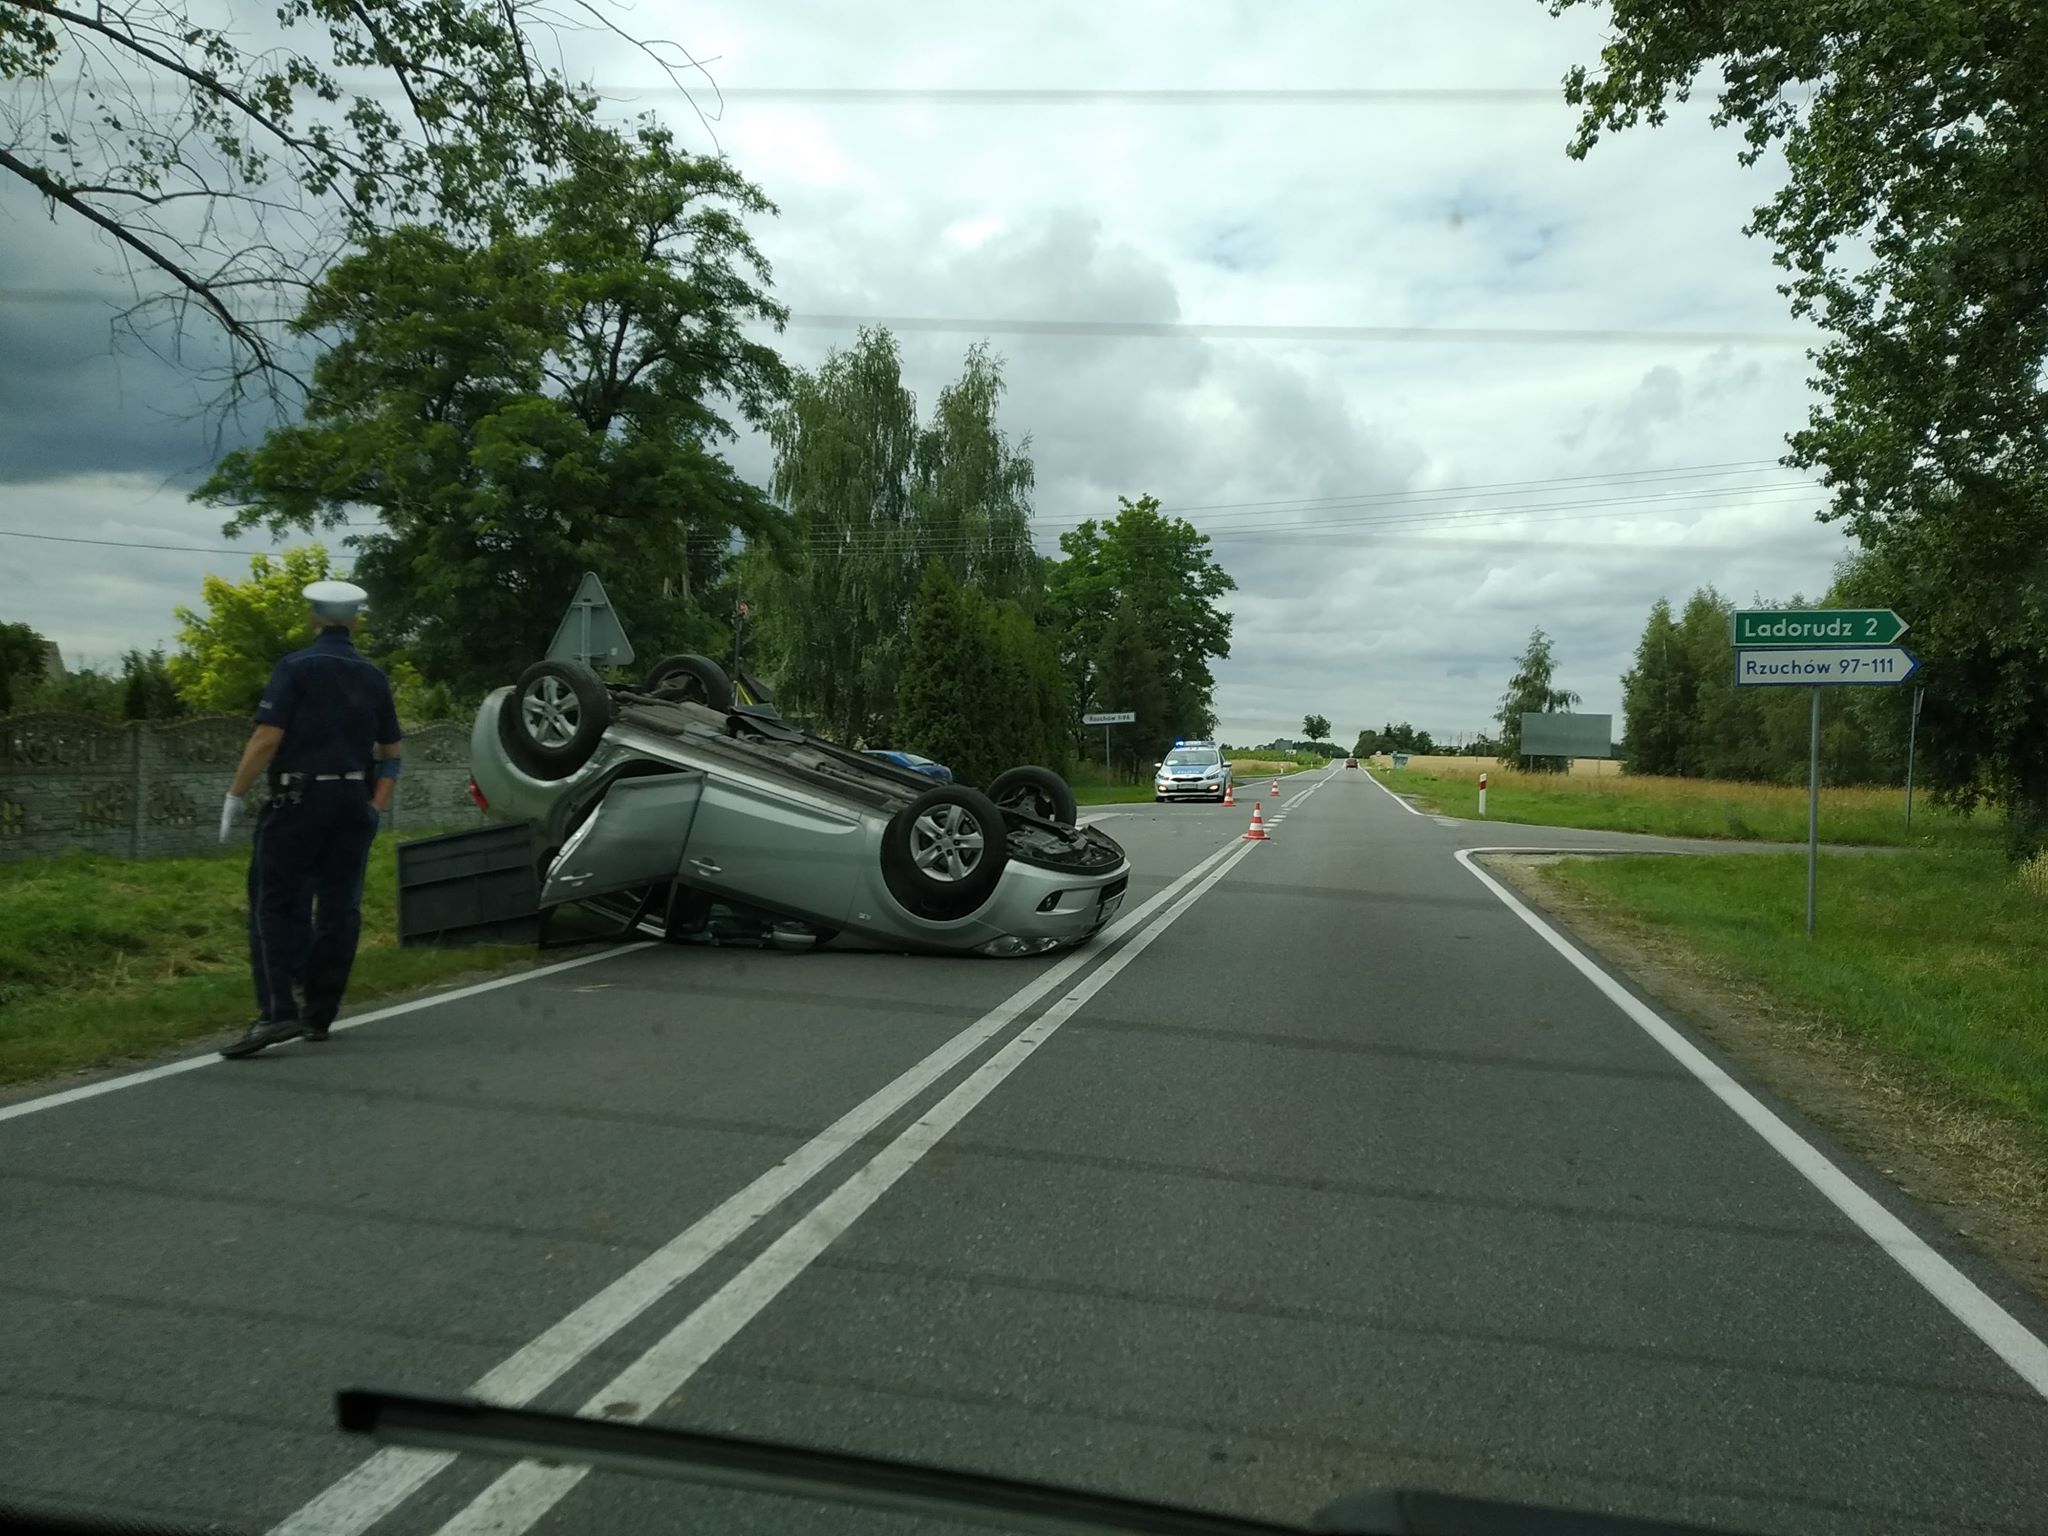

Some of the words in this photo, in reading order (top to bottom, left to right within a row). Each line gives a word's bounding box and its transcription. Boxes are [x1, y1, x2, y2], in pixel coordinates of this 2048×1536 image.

[1744, 618, 1852, 637] Ladorudz
[1865, 617, 1878, 636] 2
[1746, 659, 1831, 675] Rzuchów
[1839, 658, 1894, 674] 97-111
